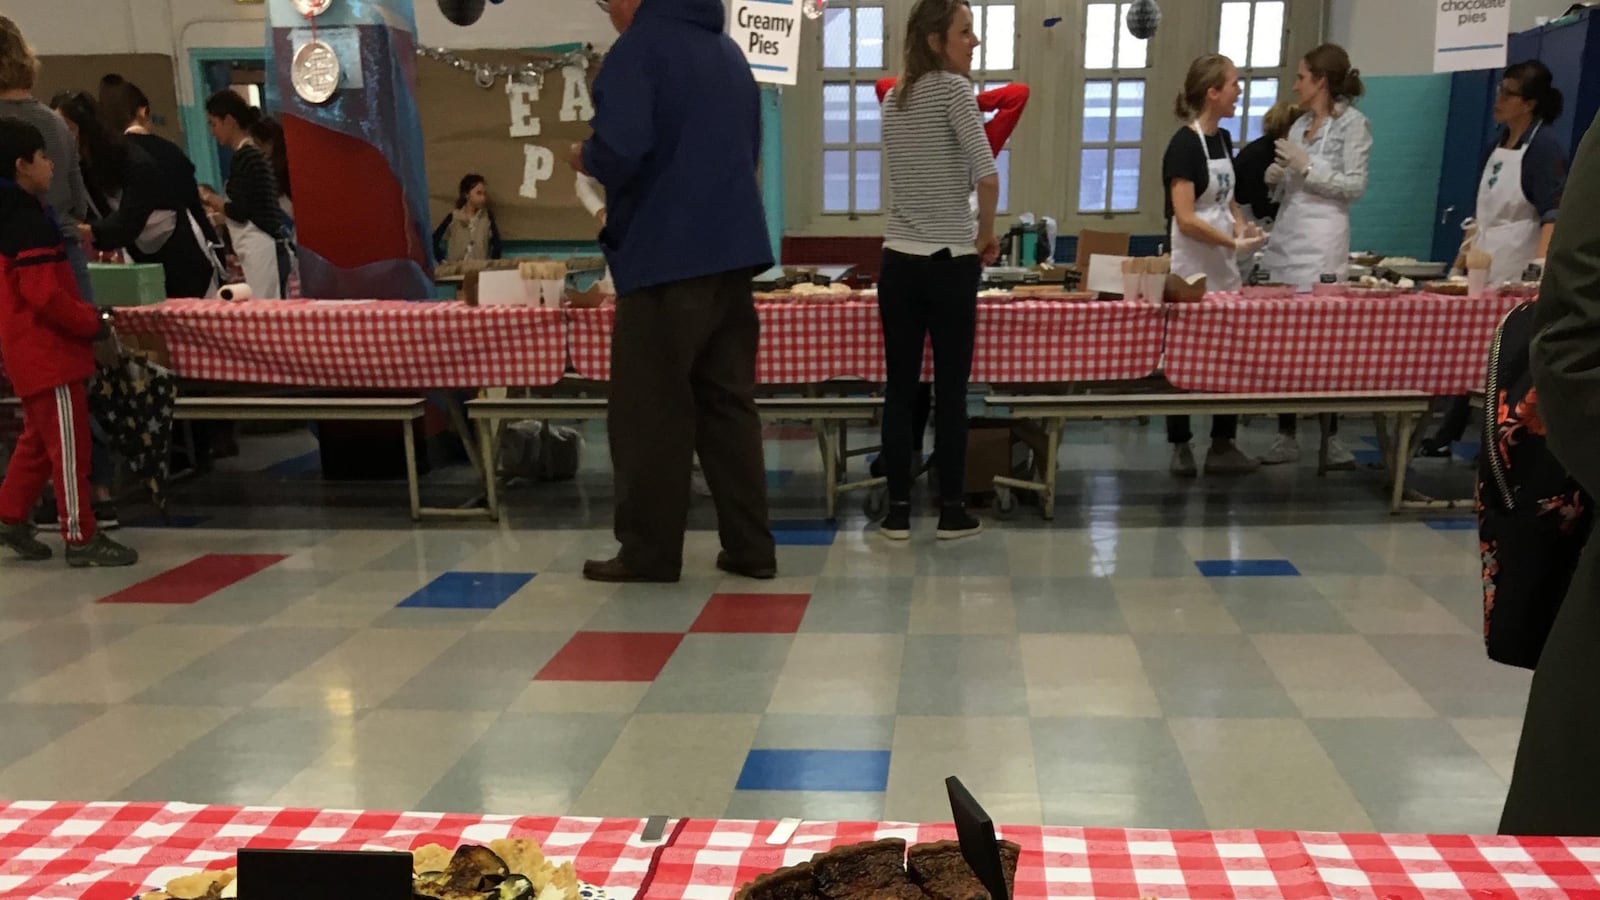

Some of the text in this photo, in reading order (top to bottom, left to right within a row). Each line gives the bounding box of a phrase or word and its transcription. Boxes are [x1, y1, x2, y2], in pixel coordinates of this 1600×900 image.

[1441, 0, 1506, 11] chocolate
[738, 6, 794, 37] Creamy
[1458, 12, 1487, 27] pies
[749, 31, 779, 55] Pies
